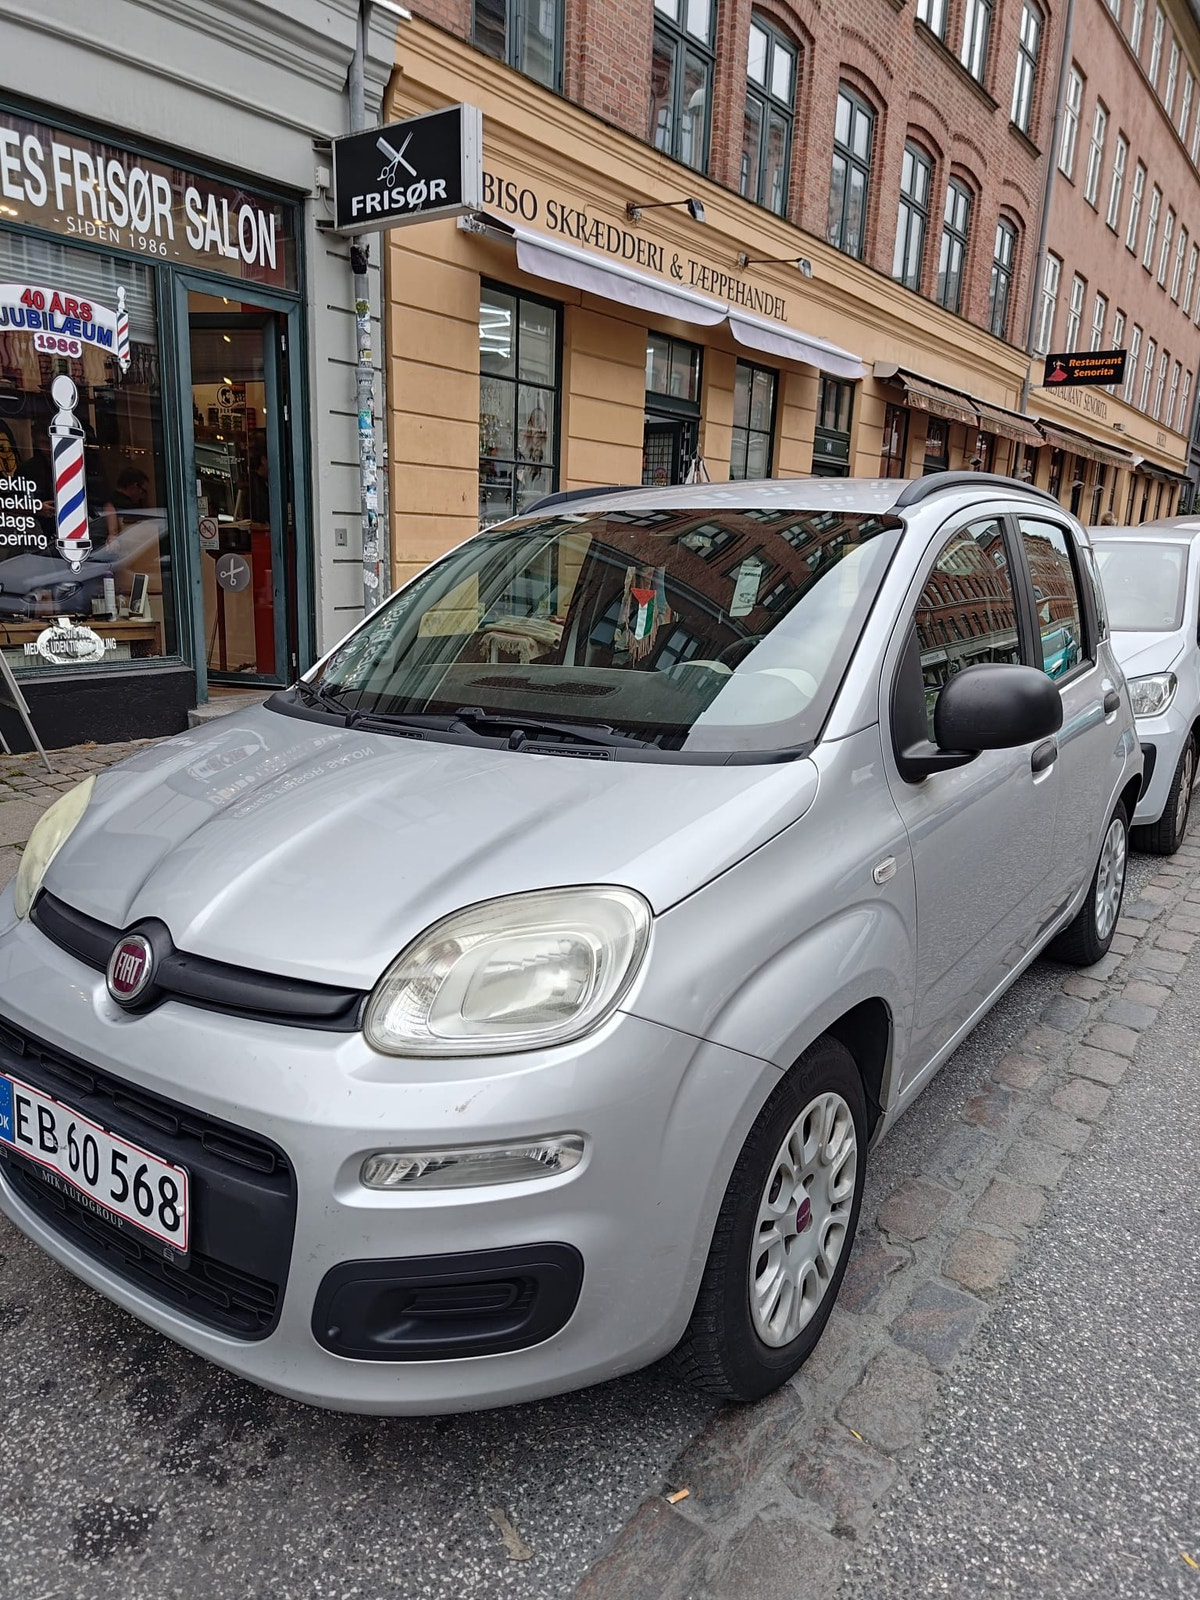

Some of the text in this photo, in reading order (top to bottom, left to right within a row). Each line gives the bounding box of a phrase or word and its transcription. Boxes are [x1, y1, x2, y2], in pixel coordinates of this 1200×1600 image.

[52, 141, 174, 240] FRISØR
[185, 187, 277, 270] SALON
[351, 178, 447, 217] FRISØR
[66, 216, 120, 244] SIDEN
[129, 234, 167, 256] 1986
[546, 200, 664, 273] SKRÆDDERI
[670, 253, 683, 280] &
[688, 259, 788, 322] TÆPPEHANDEL
[21, 288, 45, 311] 40
[0, 306, 113, 348] JUBILÆUM
[37, 334, 79, 355] 1986
[1069, 356, 1122, 367] Restaurant
[1073, 368, 1114, 377] Senorita
[114, 951, 143, 985] FIAT
[15, 1093, 181, 1232] EB 60 568
[42, 1170, 124, 1228] MTK AUTOGROUP
